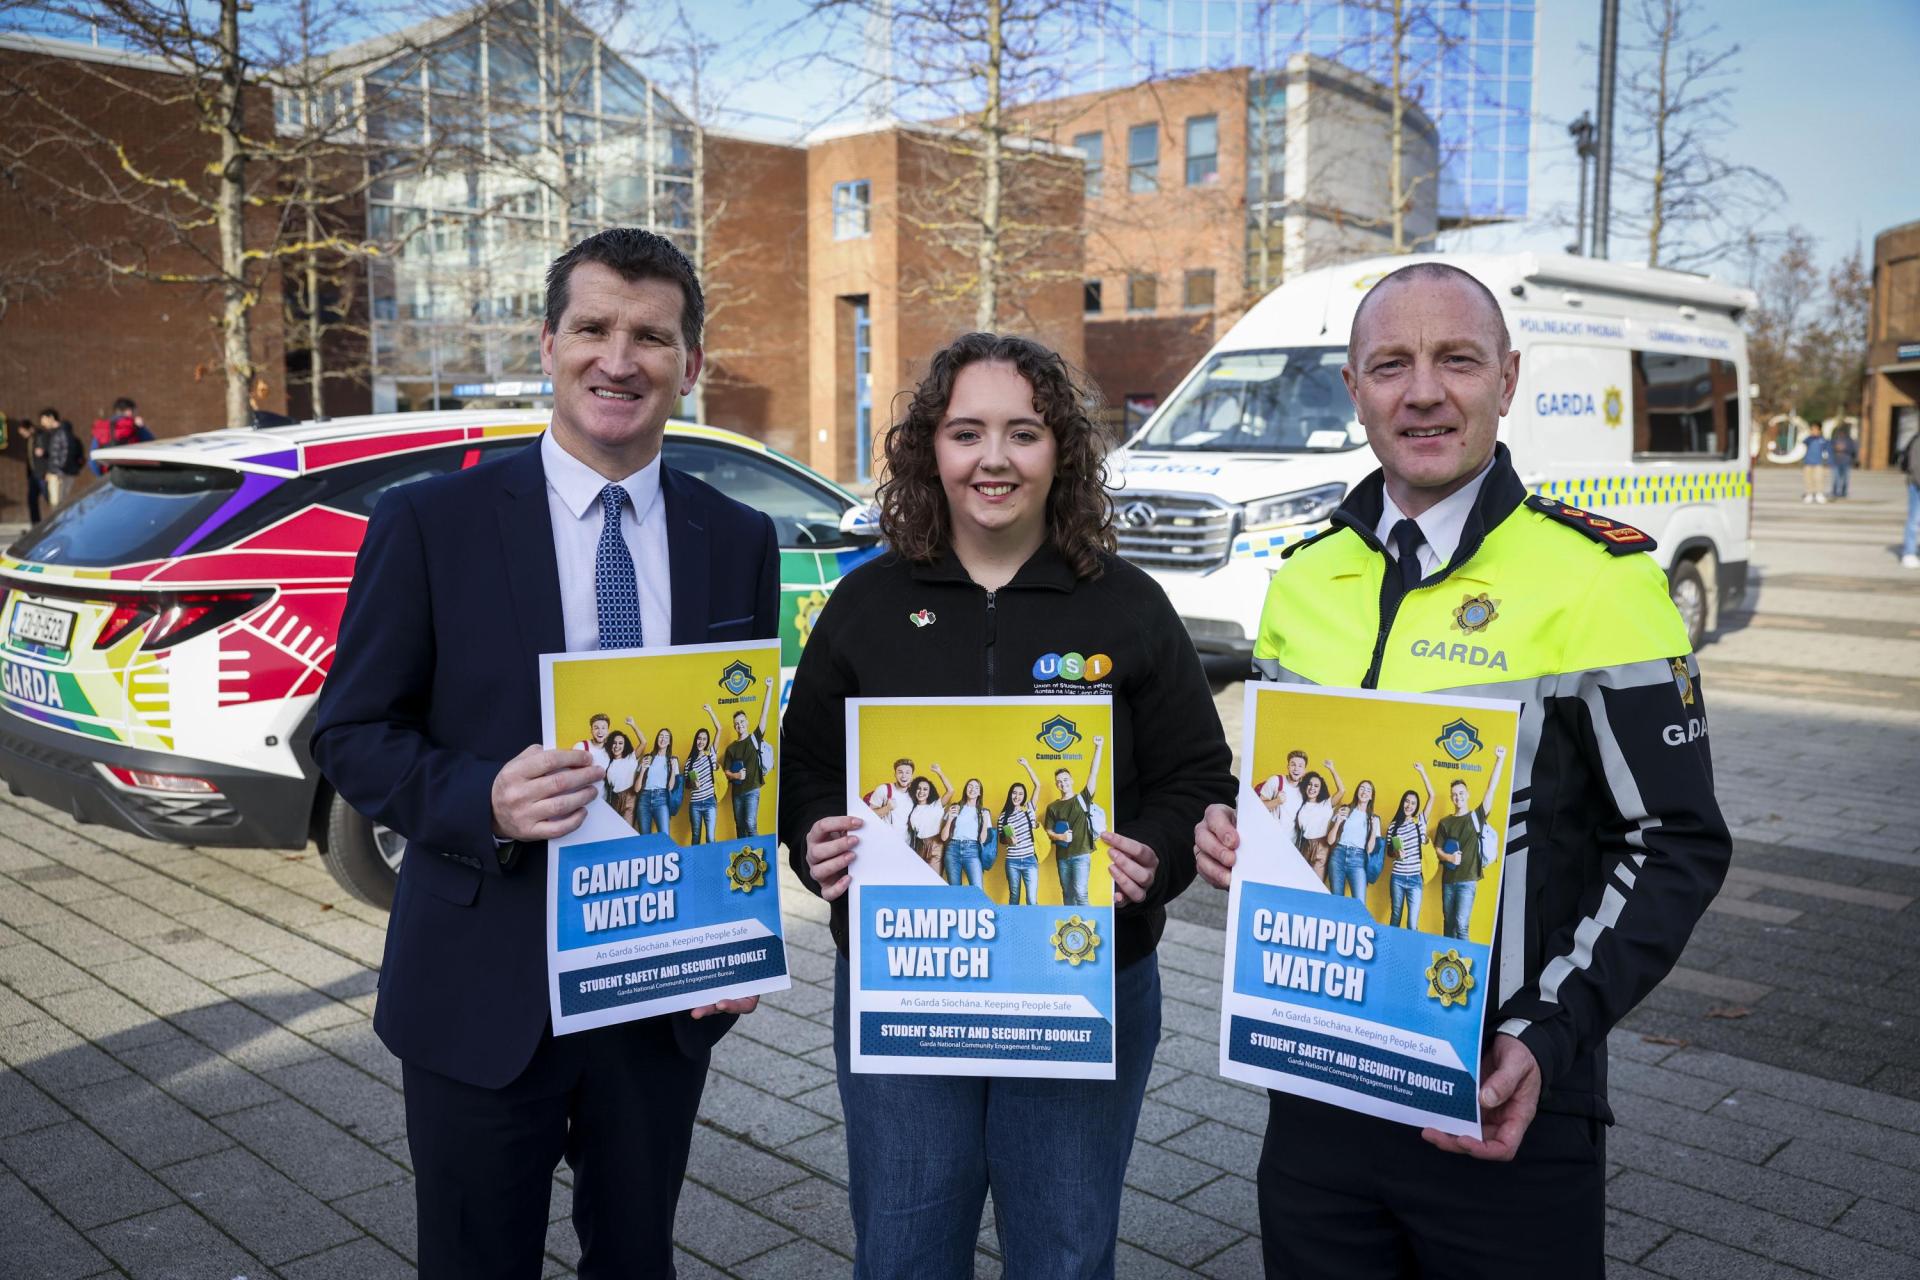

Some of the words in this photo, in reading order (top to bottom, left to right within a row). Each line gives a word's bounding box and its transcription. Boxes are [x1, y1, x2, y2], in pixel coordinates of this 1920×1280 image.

[1536, 393, 1596, 417] GARDA
[1040, 658, 1101, 674] USI
[1410, 639, 1508, 671] GARDA
[1, 660, 64, 709] GARDA
[718, 697, 739, 705] Campus
[740, 695, 757, 703] Watch
[1433, 759, 1459, 769] Campus
[1461, 762, 1482, 772] Watch
[572, 852, 681, 898] CAMPUS
[582, 889, 676, 933] WATCH
[875, 908, 996, 940] CAMPUS
[596, 951, 608, 960] An
[609, 947, 633, 958] Garda
[672, 933, 704, 948] Keeping
[705, 928, 731, 942] People
[732, 926, 748, 936] Safe
[1252, 908, 1375, 961] CAMPUS
[579, 975, 623, 994] STUDENT
[624, 968, 659, 985] SAFETY
[660, 964, 680, 979] AND
[681, 956, 726, 975] SECURITY
[727, 949, 767, 966] BOOKLET
[887, 946, 989, 978] WATCH
[1262, 951, 1366, 1002] WATCH
[617, 988, 633, 996] Garda
[633, 984, 655, 993] National
[655, 978, 685, 989] Community
[685, 973, 717, 984] Engagement
[900, 998, 913, 1006] An
[914, 998, 940, 1007] Garda
[984, 999, 1020, 1011] Keeping
[1022, 1000, 1051, 1011] People
[1053, 1001, 1072, 1011] Safe
[881, 1024, 927, 1037] STUDENT
[929, 1025, 966, 1038] SAFETY
[967, 1026, 990, 1039] AND
[991, 1027, 1042, 1041] SECURITY
[1044, 1029, 1092, 1042] BOOKLET
[961, 1041, 994, 1050] Community
[995, 1043, 1030, 1051] Engagement
[1031, 1043, 1052, 1051] Bureau
[1271, 1007, 1284, 1018] An
[1285, 1010, 1311, 1024] Garda
[1354, 1026, 1388, 1043] Keeping
[1390, 1035, 1418, 1050] People
[1419, 1043, 1437, 1056] Safe
[1250, 1032, 1297, 1053] STUDENT
[1297, 1042, 1335, 1063] SAFETY
[1335, 1052, 1357, 1069] AND
[1358, 1057, 1407, 1083] SECURITY
[1407, 1071, 1455, 1096] BOOKLET
[1287, 1056, 1305, 1066] Garda
[1305, 1060, 1329, 1072] National
[1328, 1066, 1360, 1081] Community
[1359, 1075, 1393, 1090] Engagement
[1393, 1085, 1414, 1096] Bureau
